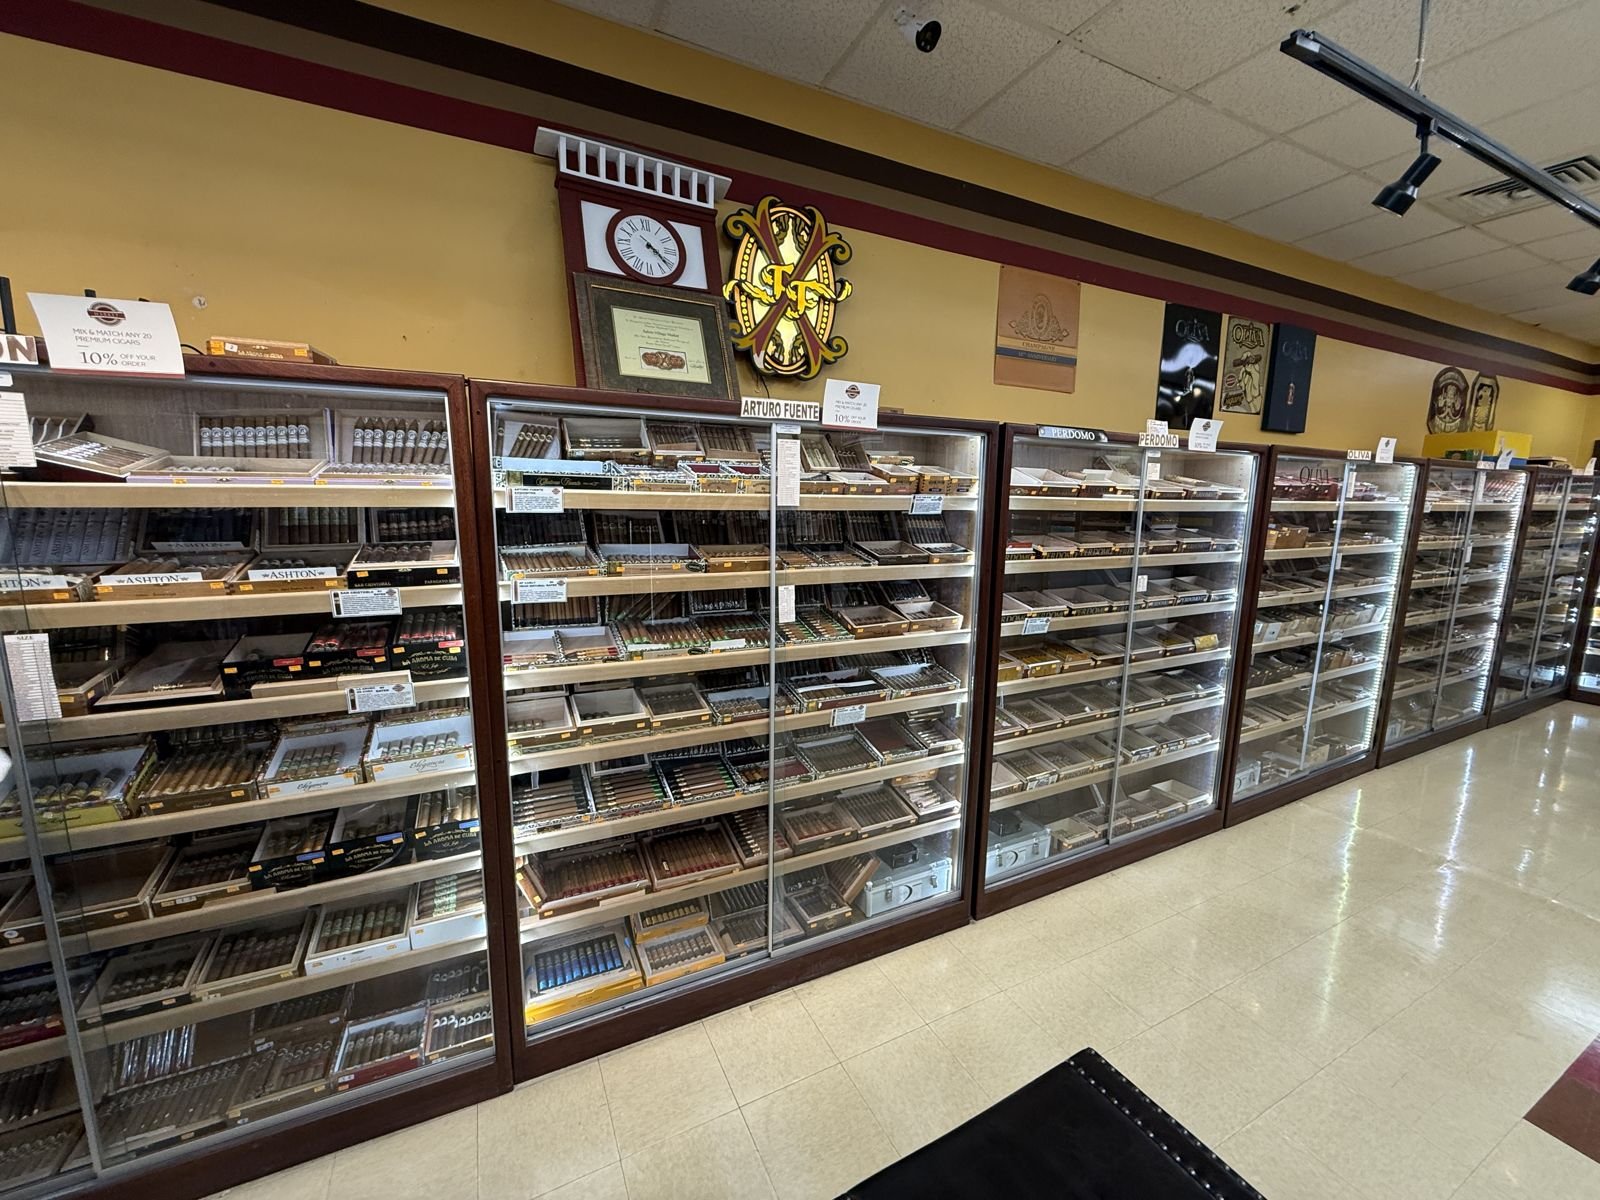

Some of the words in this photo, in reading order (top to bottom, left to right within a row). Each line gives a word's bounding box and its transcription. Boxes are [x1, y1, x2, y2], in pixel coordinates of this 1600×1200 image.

[75, 335, 111, 344] PREMIUM
[96, 329, 124, 337] MATCH
[142, 332, 153, 340] 20
[1232, 322, 1265, 349] OLIVA
[80, 351, 118, 366] 10%
[743, 399, 781, 417] ARTURO
[784, 403, 819, 420] FUENTE
[834, 413, 850, 423] 10%
[1051, 428, 1095, 441] PERDOMO
[1139, 435, 1178, 447] PERDOMO
[1348, 450, 1370, 459] OLIVA
[126, 574, 180, 584] ASHTON
[270, 569, 317, 579] ASHTON
[411, 655, 433, 664] AROMA
[432, 835, 454, 845] AROMA
[461, 831, 477, 839] CUBA
